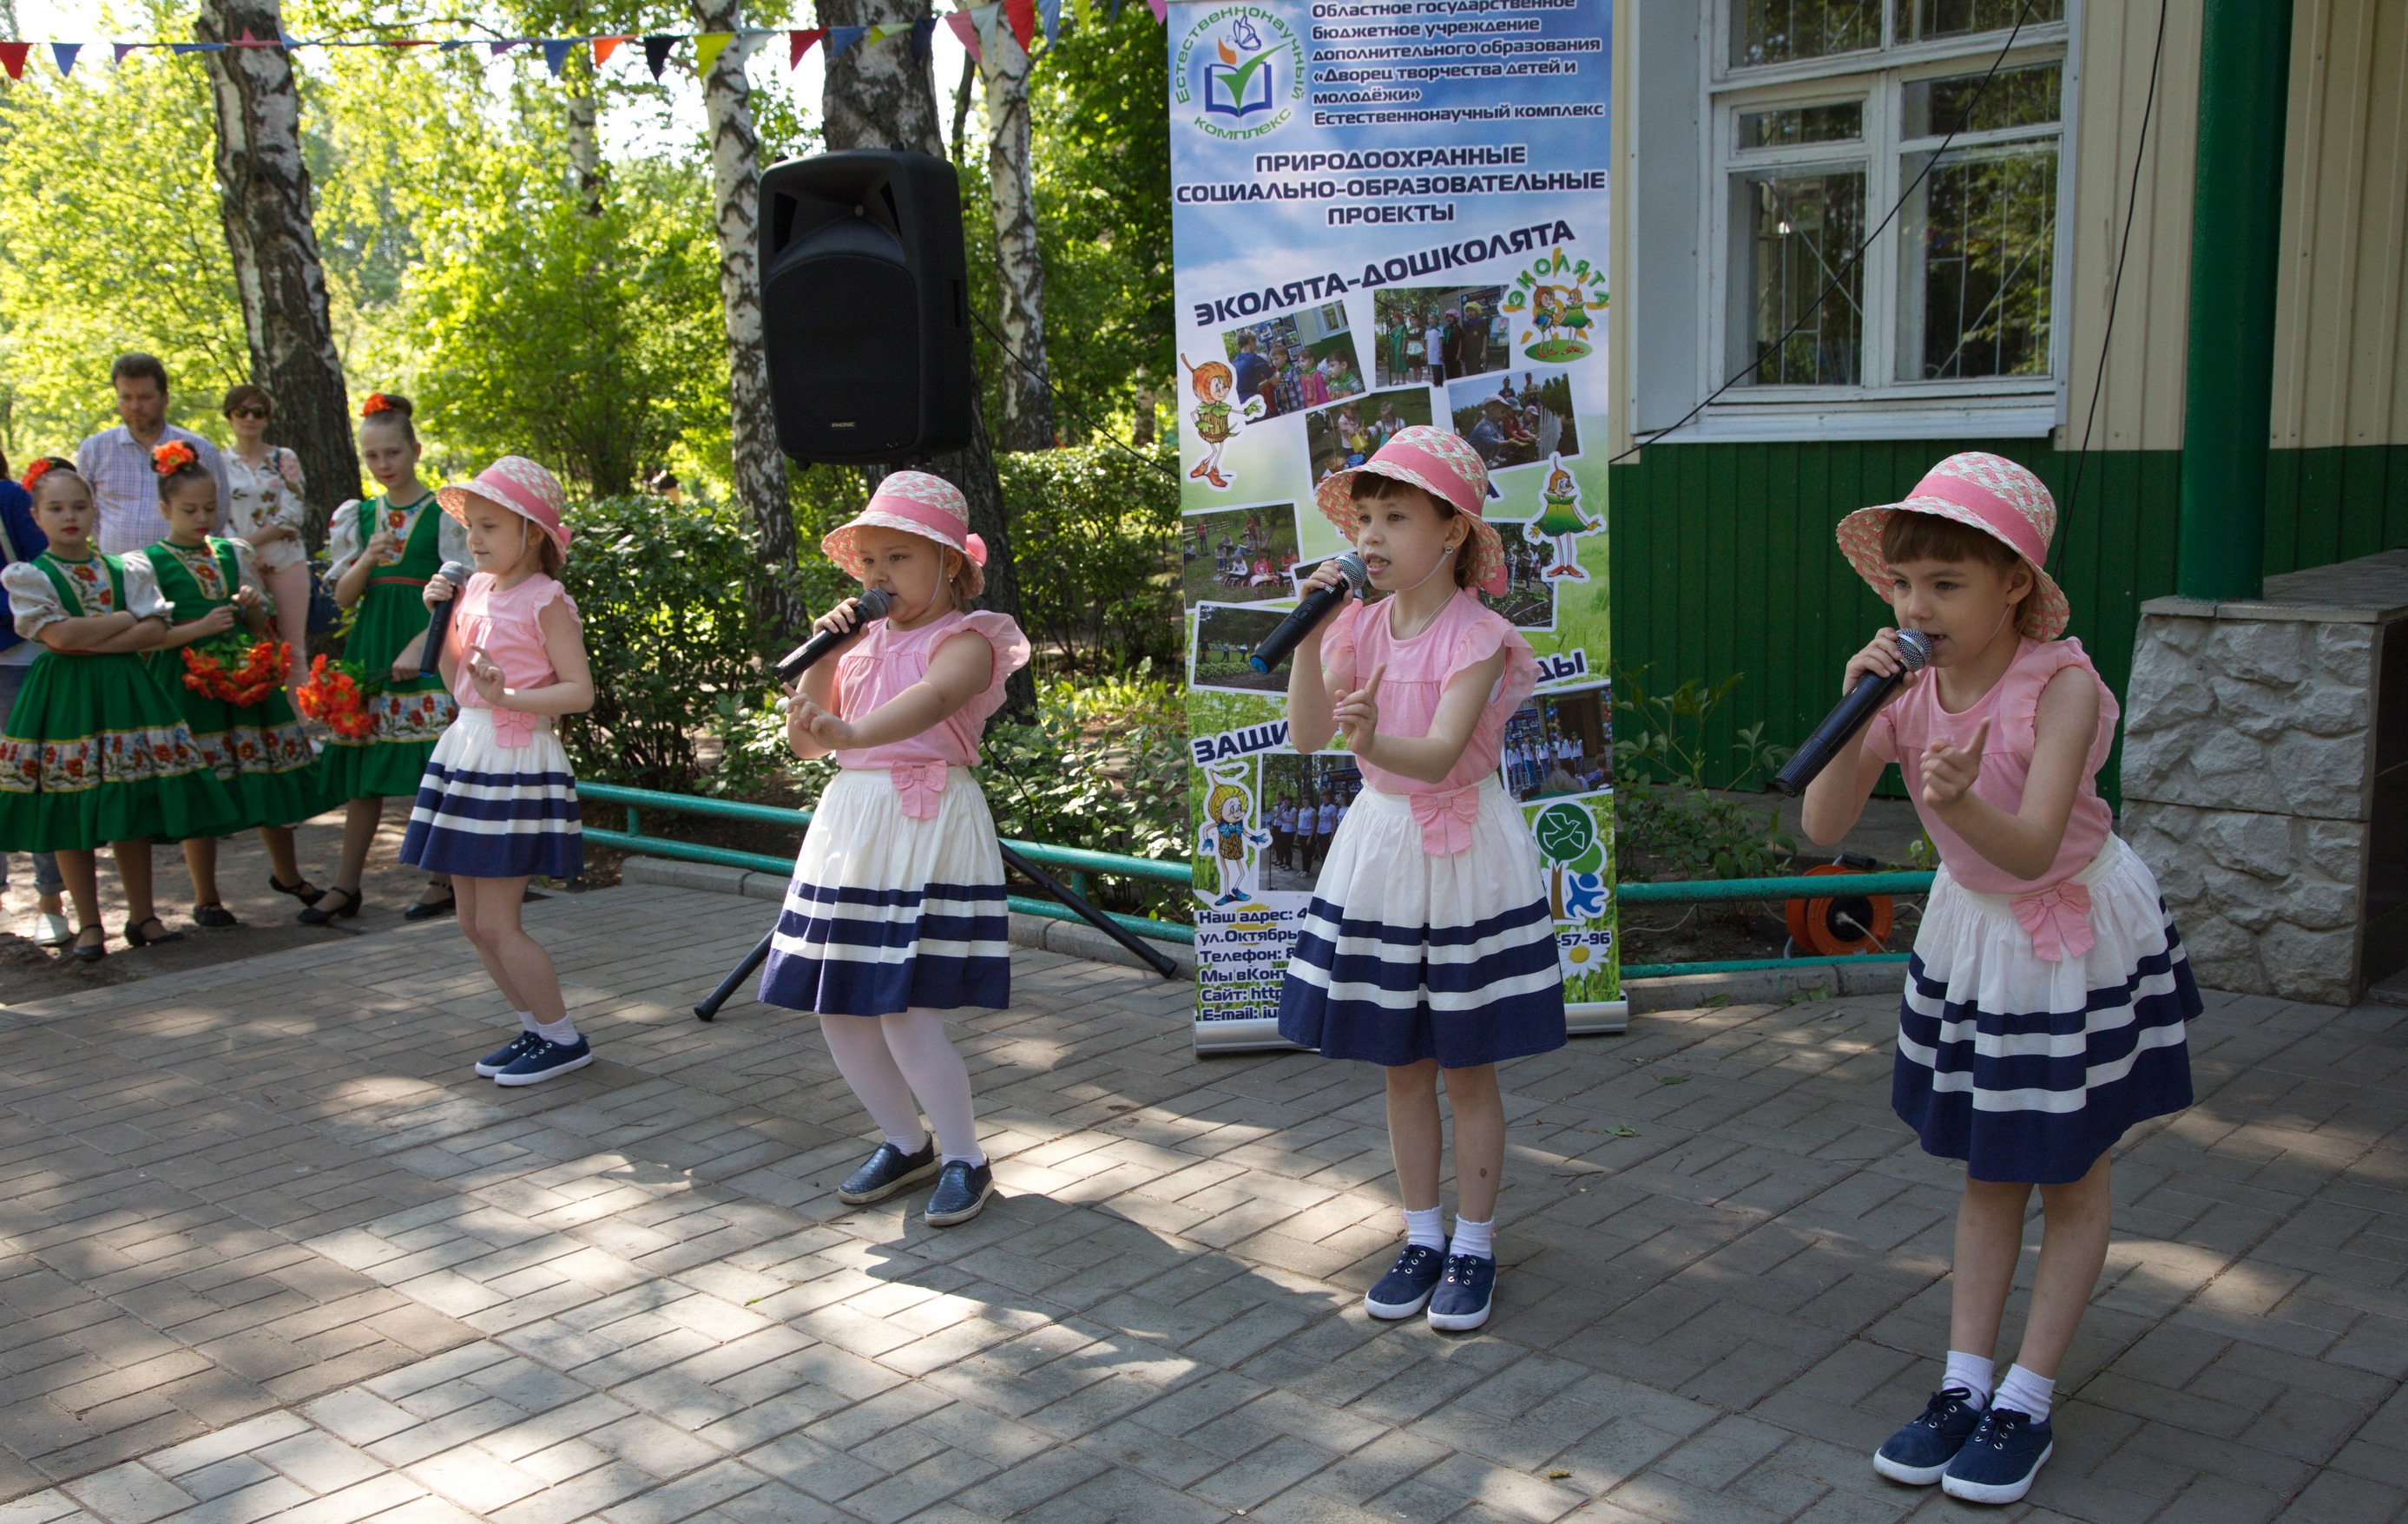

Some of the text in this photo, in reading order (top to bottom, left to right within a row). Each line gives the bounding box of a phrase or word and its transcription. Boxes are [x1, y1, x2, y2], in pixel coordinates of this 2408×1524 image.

[1313, 0, 1576, 17] Областное государственное
[1313, 19, 1540, 40] бюджетное учреждение
[1175, 6, 1305, 104] Естественнонаучный
[1313, 39, 1601, 62] дополнительного образования
[1313, 60, 1576, 83] «Дворец творчества детей и
[1313, 88, 1421, 104] молодёжи»
[1194, 108, 1292, 141] комплекс
[1314, 104, 1604, 125] Естественнонаучный комплекс
[1256, 146, 1526, 173] ПРИРОДООХРАННЫЕ
[1177, 171, 1606, 203] СОЦИАЛЬНО-ОБРАЗОВАТЕЛЬНЫЕ
[1328, 203, 1454, 226] ПРОЕКТЫ
[1194, 220, 1576, 327] ЭКОЛЯТА-ДОШКОЛЯТА
[1199, 911, 1236, 924] Наш
[1240, 910, 1293, 924] адрес:
[1200, 949, 1281, 963] Телефон:
[1201, 969, 1233, 982] Мы
[1201, 989, 1247, 1002] Сайт:
[1202, 1007, 1258, 1021] E-mail:
